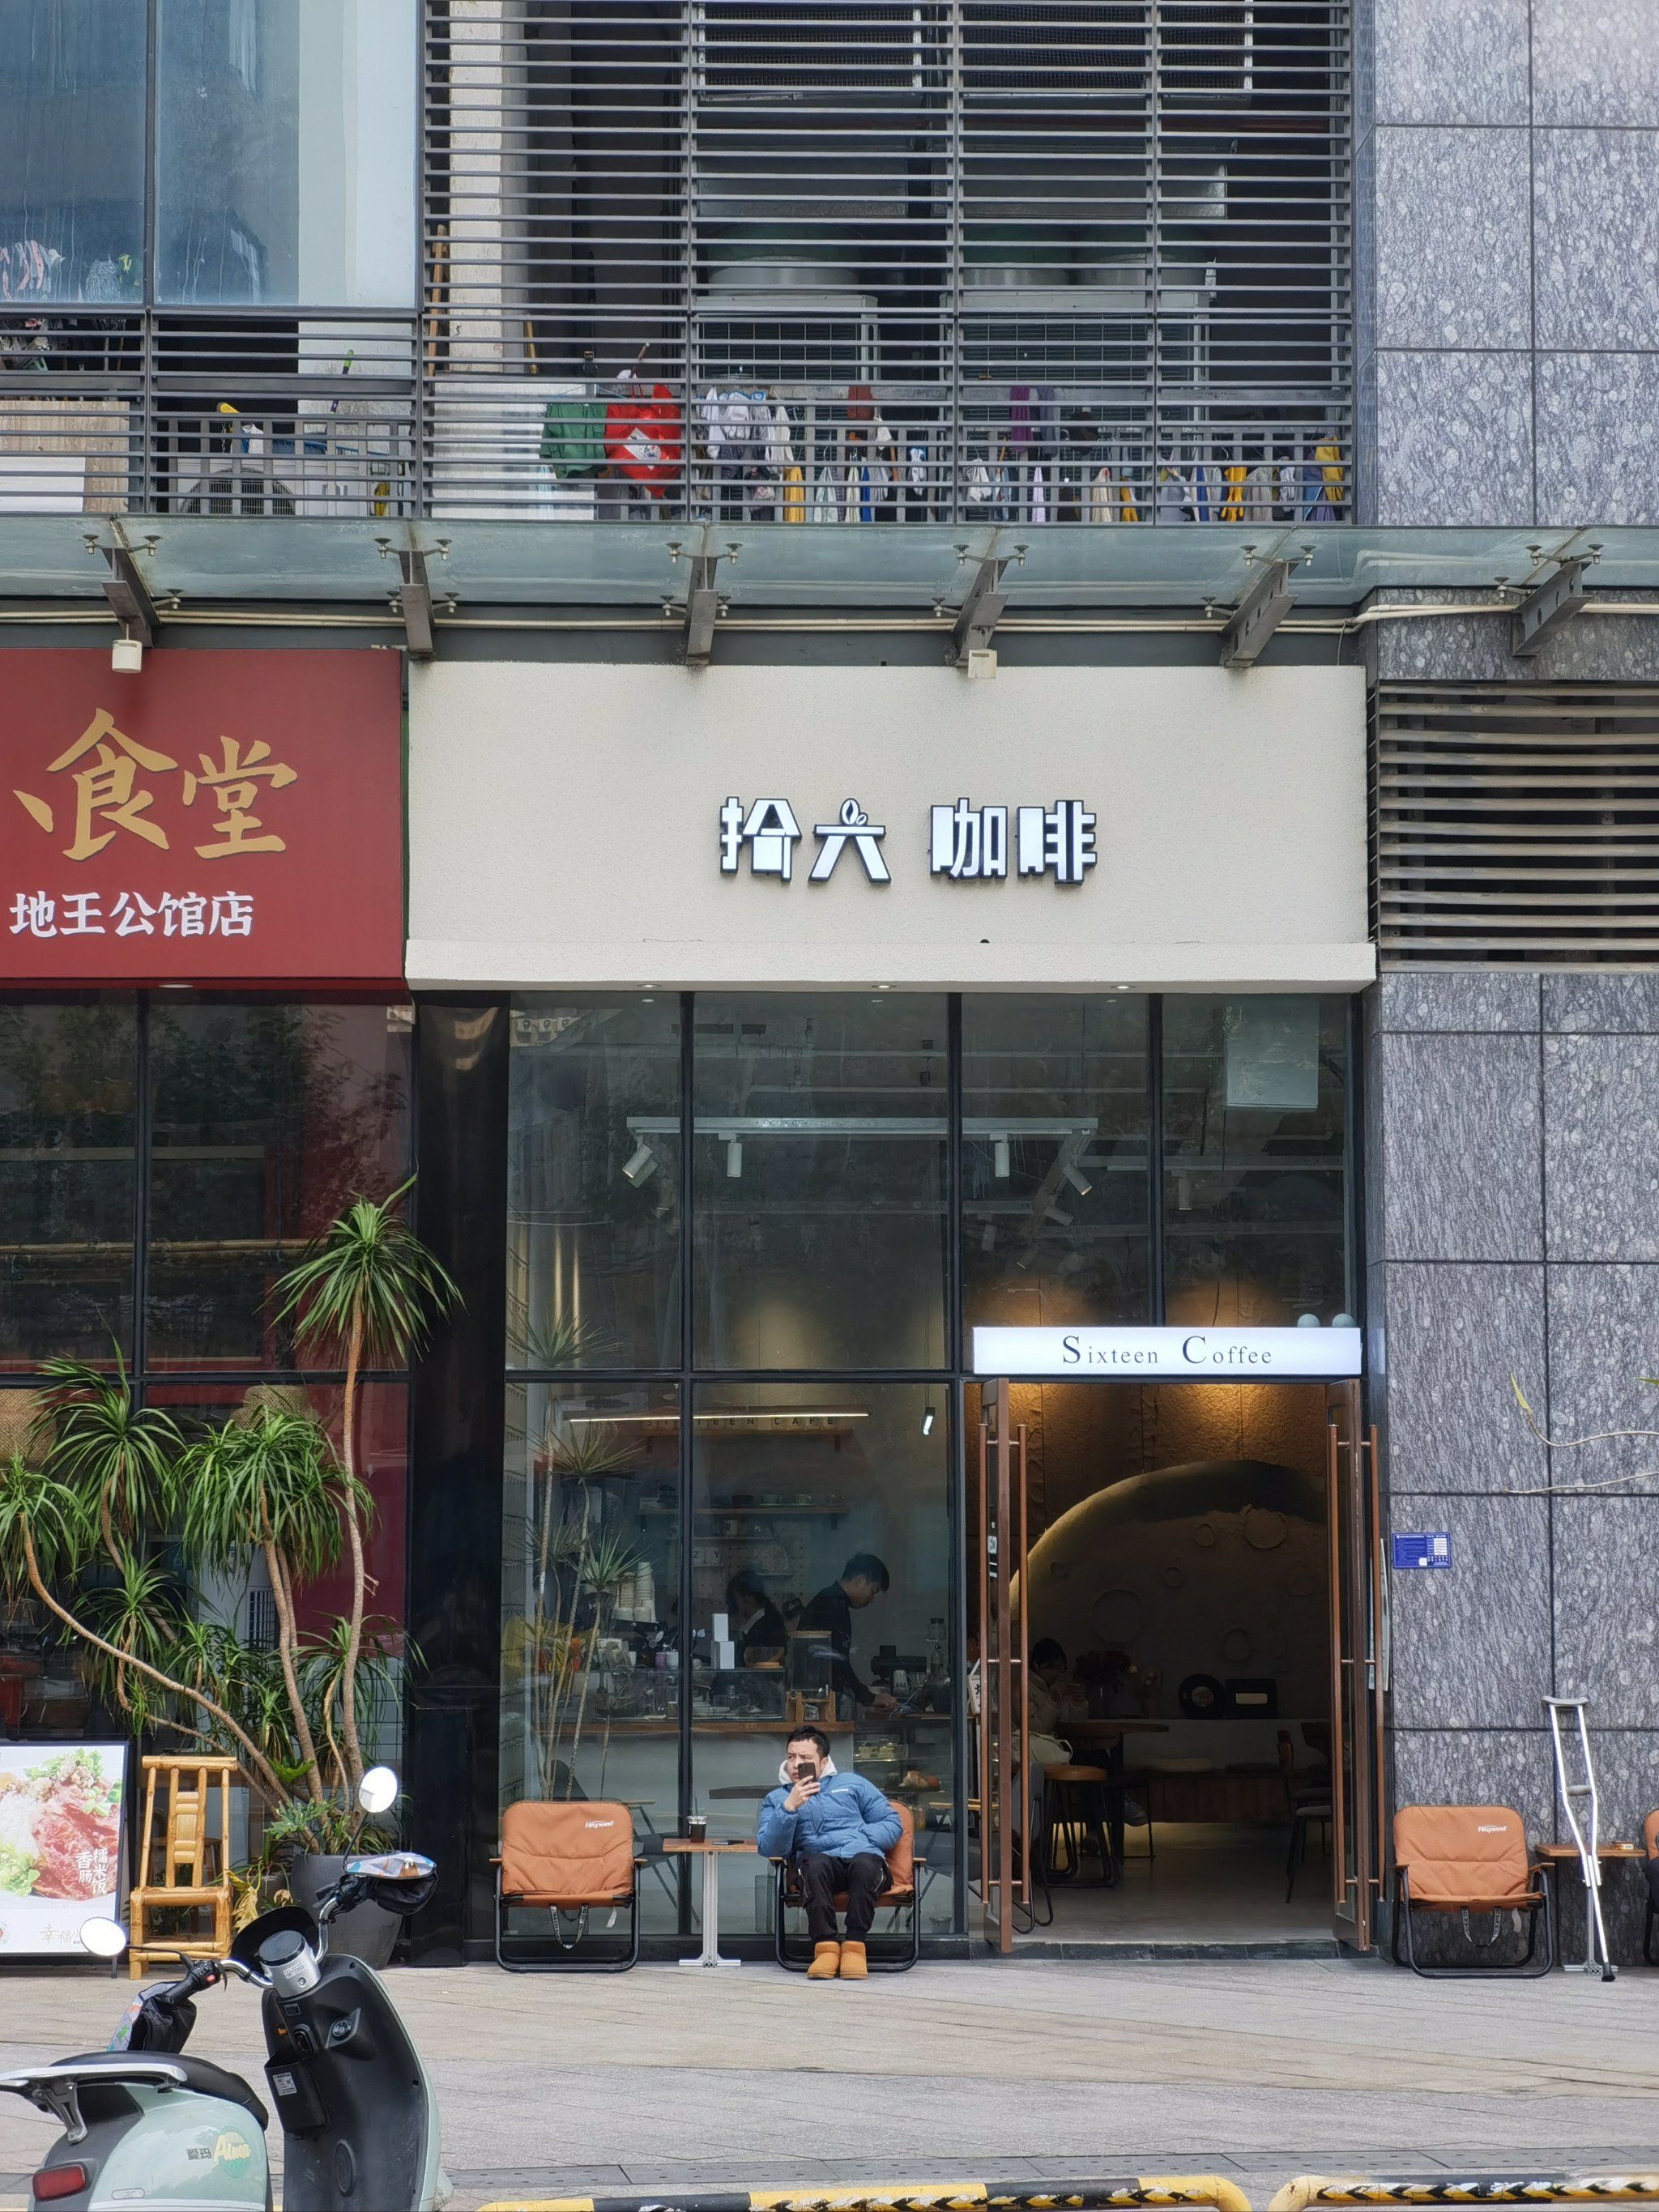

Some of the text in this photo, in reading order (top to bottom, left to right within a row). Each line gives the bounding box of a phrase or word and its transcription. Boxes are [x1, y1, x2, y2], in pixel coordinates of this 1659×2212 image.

[930, 798, 1096, 884] 咖啡
[9, 891, 254, 938] 地王公馆店
[1063, 1335, 1272, 1364] Sixteen Coffee
[774, 1417, 834, 1426] CAFE
[75, 1851, 93, 1883] 香肠
